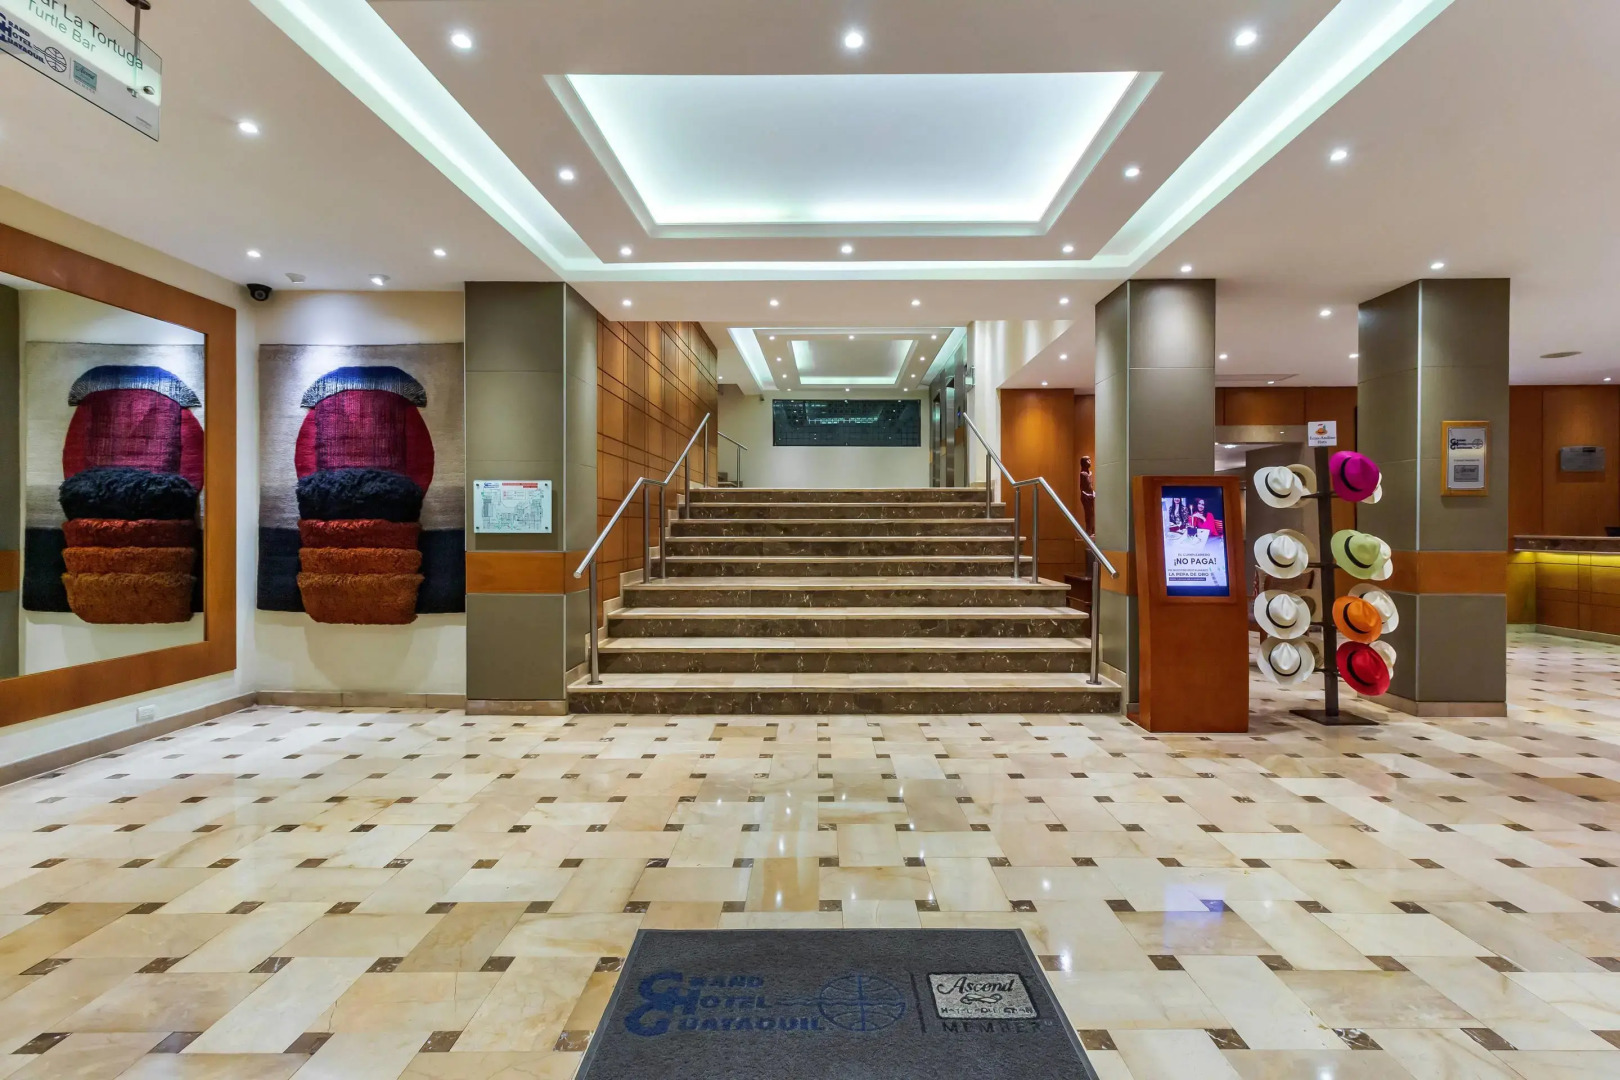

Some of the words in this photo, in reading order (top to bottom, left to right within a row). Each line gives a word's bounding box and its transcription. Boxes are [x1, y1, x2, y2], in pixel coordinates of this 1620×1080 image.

[28, 0, 68, 34] Turtle
[71, 27, 97, 53] Bar
[40, 0, 56, 10] ar
[63, 4, 83, 30] La
[88, 20, 144, 71] Tortuga
[1174, 558, 1189, 566] ¡NO
[937, 976, 1015, 995] Ascend
